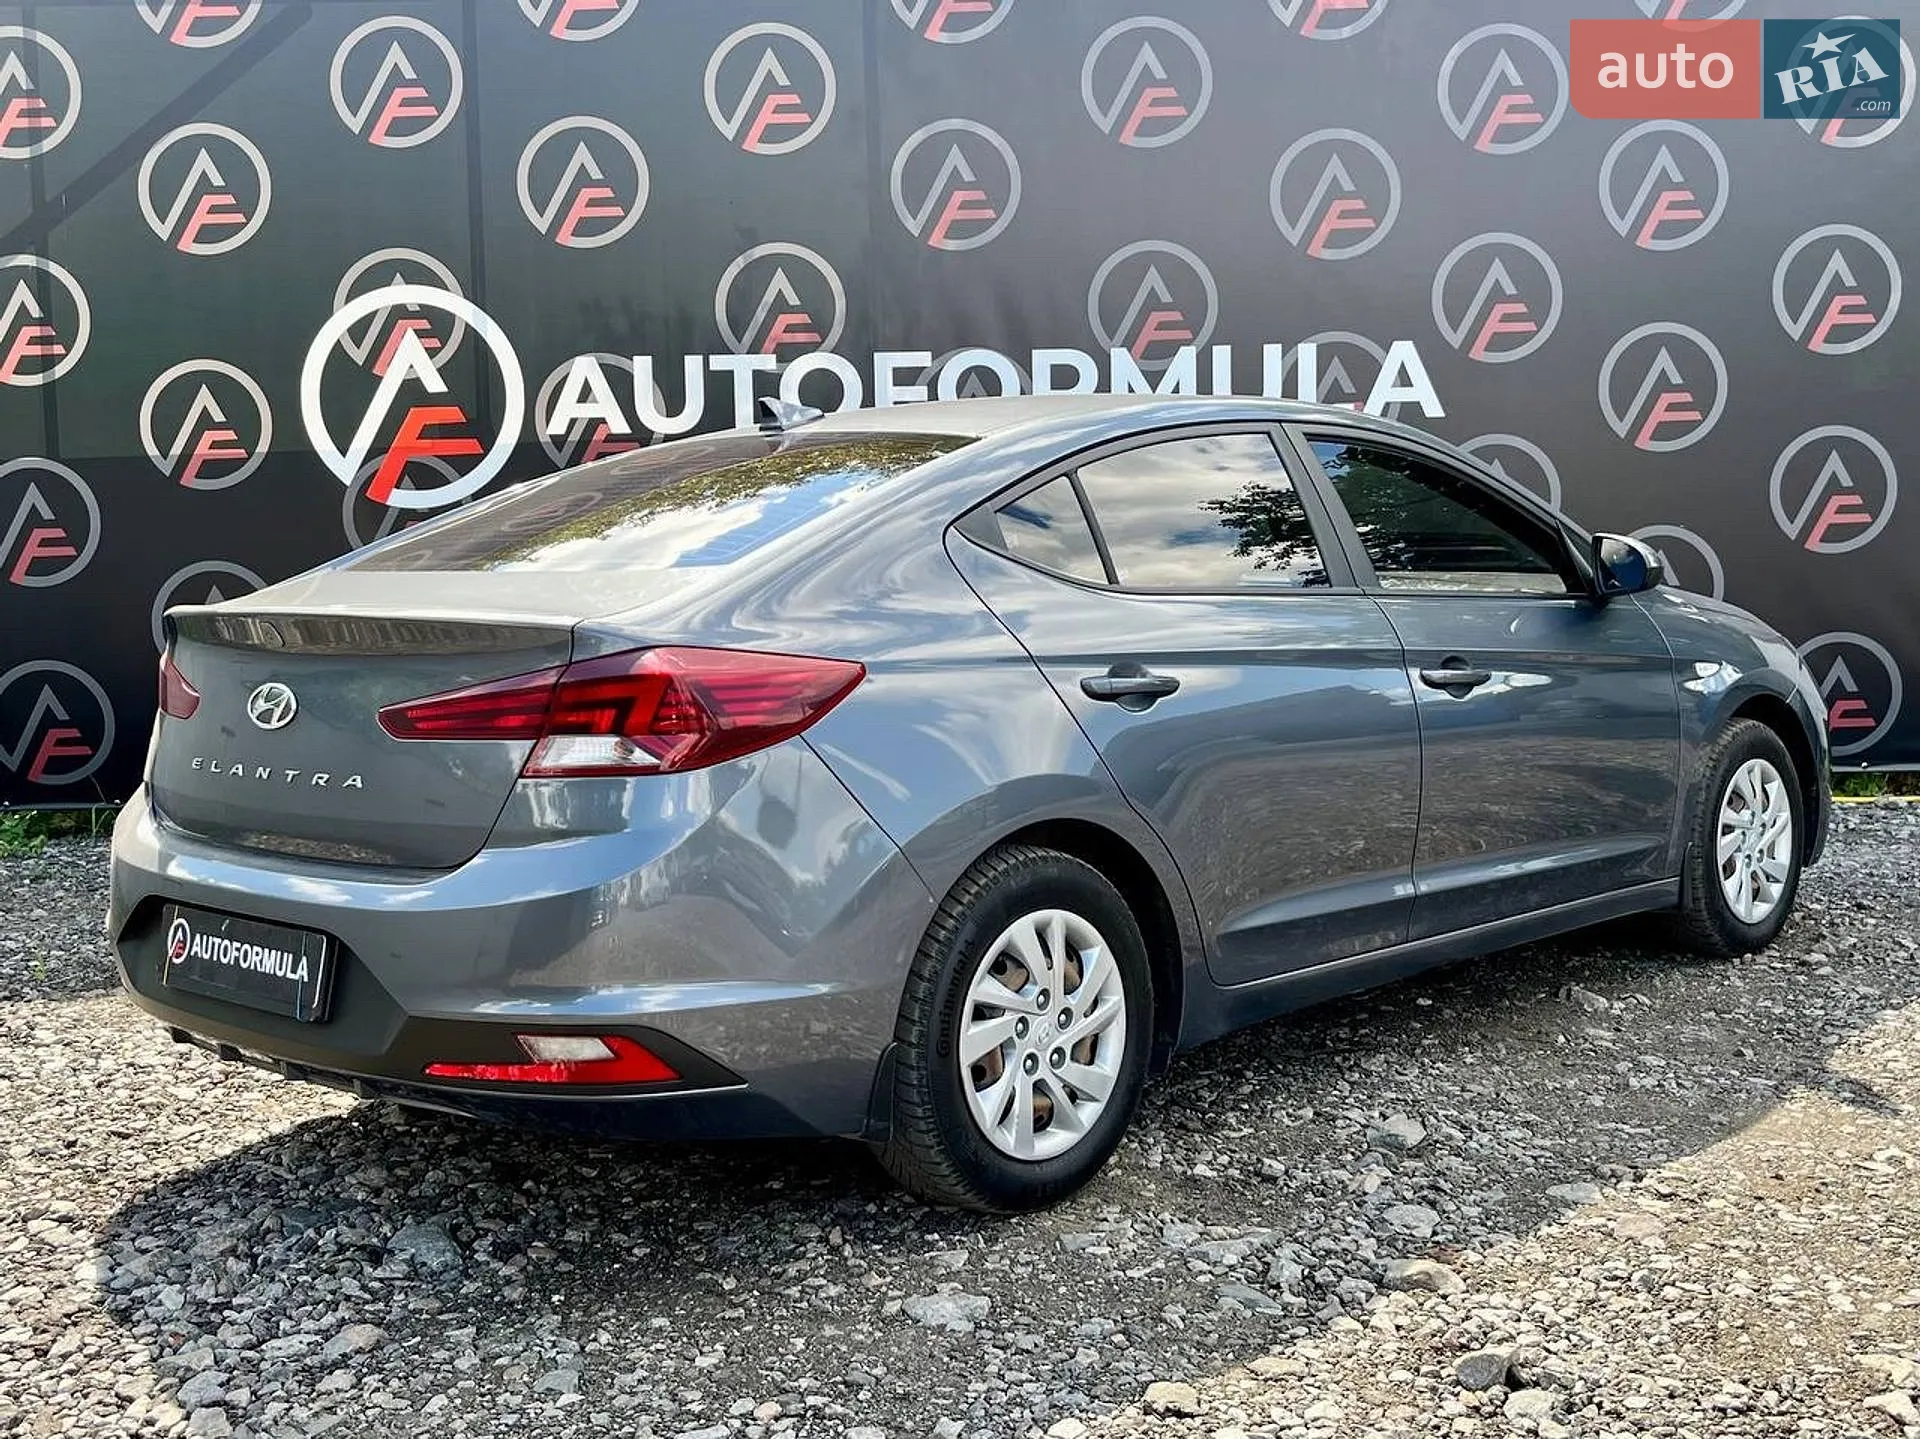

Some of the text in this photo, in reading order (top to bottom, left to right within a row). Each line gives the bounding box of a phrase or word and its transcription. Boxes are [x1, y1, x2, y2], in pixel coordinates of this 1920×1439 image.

[338, 323, 486, 504] AF
[545, 340, 1446, 435] AUTOFORMULA
[191, 757, 365, 790] ELANTRA
[190, 933, 309, 982] AUTOFORMULA
